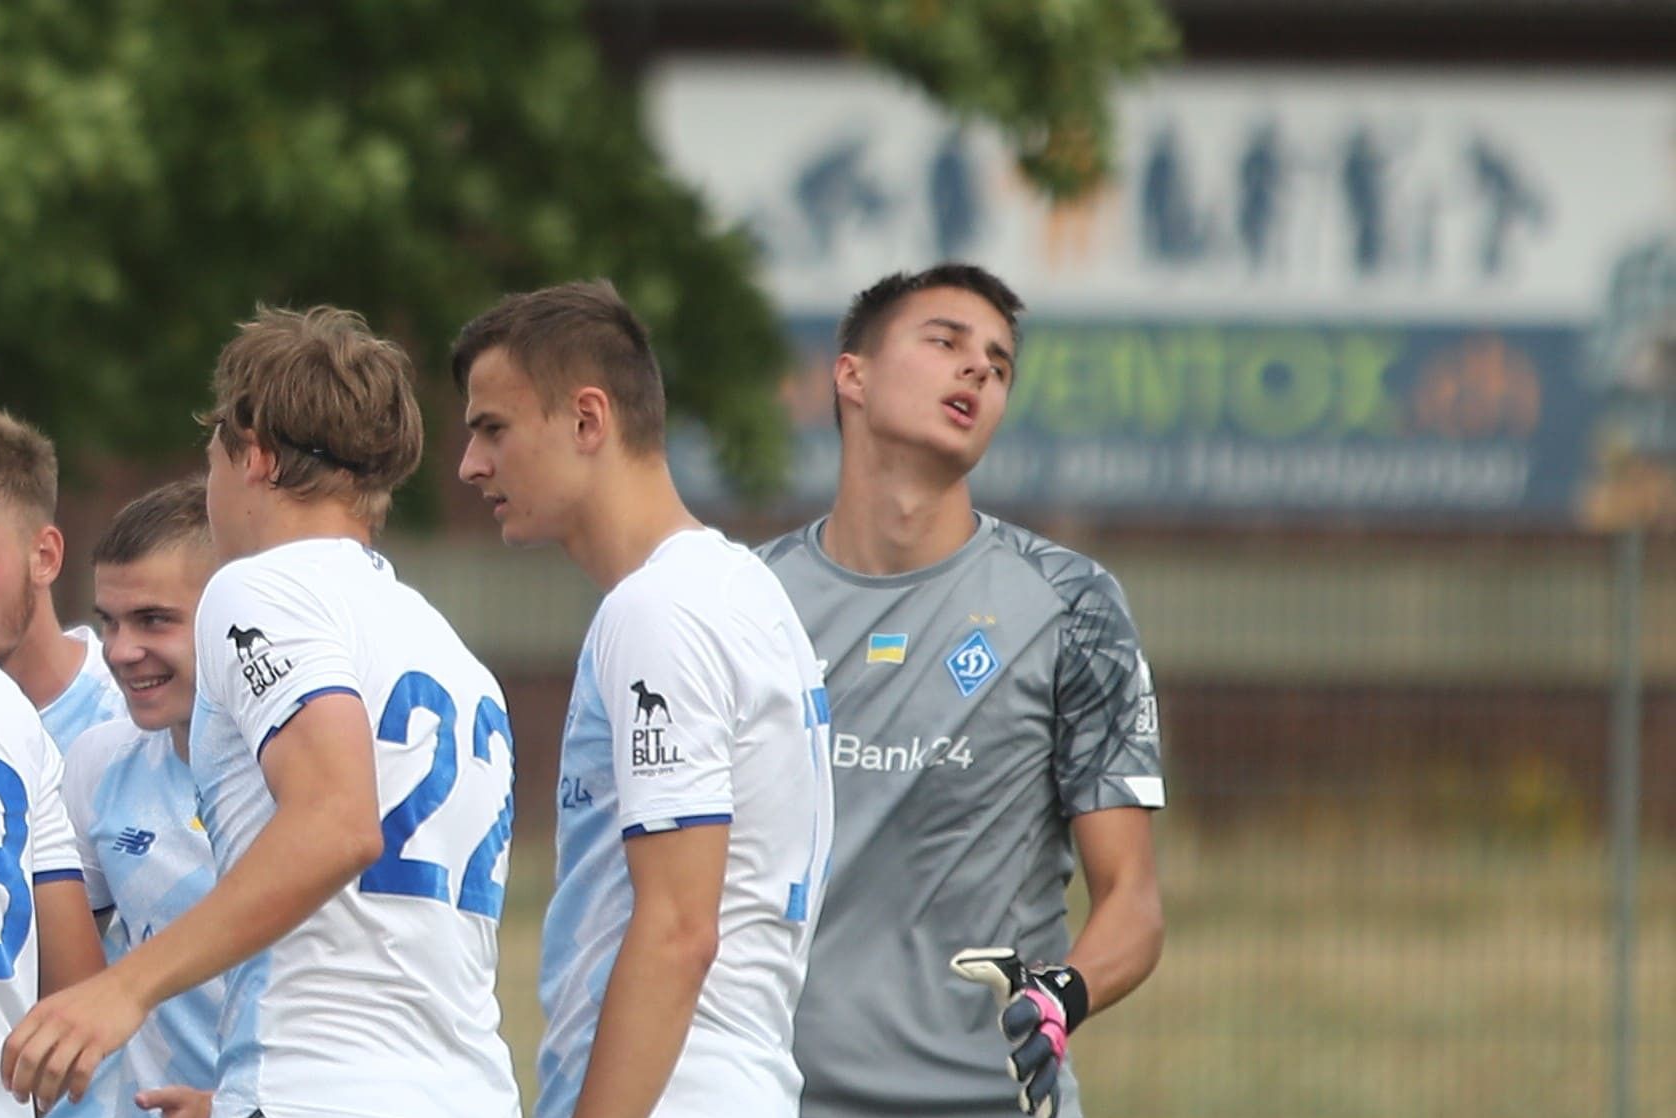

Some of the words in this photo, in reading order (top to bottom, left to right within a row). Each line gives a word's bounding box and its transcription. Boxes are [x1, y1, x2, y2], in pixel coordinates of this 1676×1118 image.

[242, 651, 271, 685] PIT
[632, 728, 666, 749] PIT
[632, 745, 685, 767] BULL
